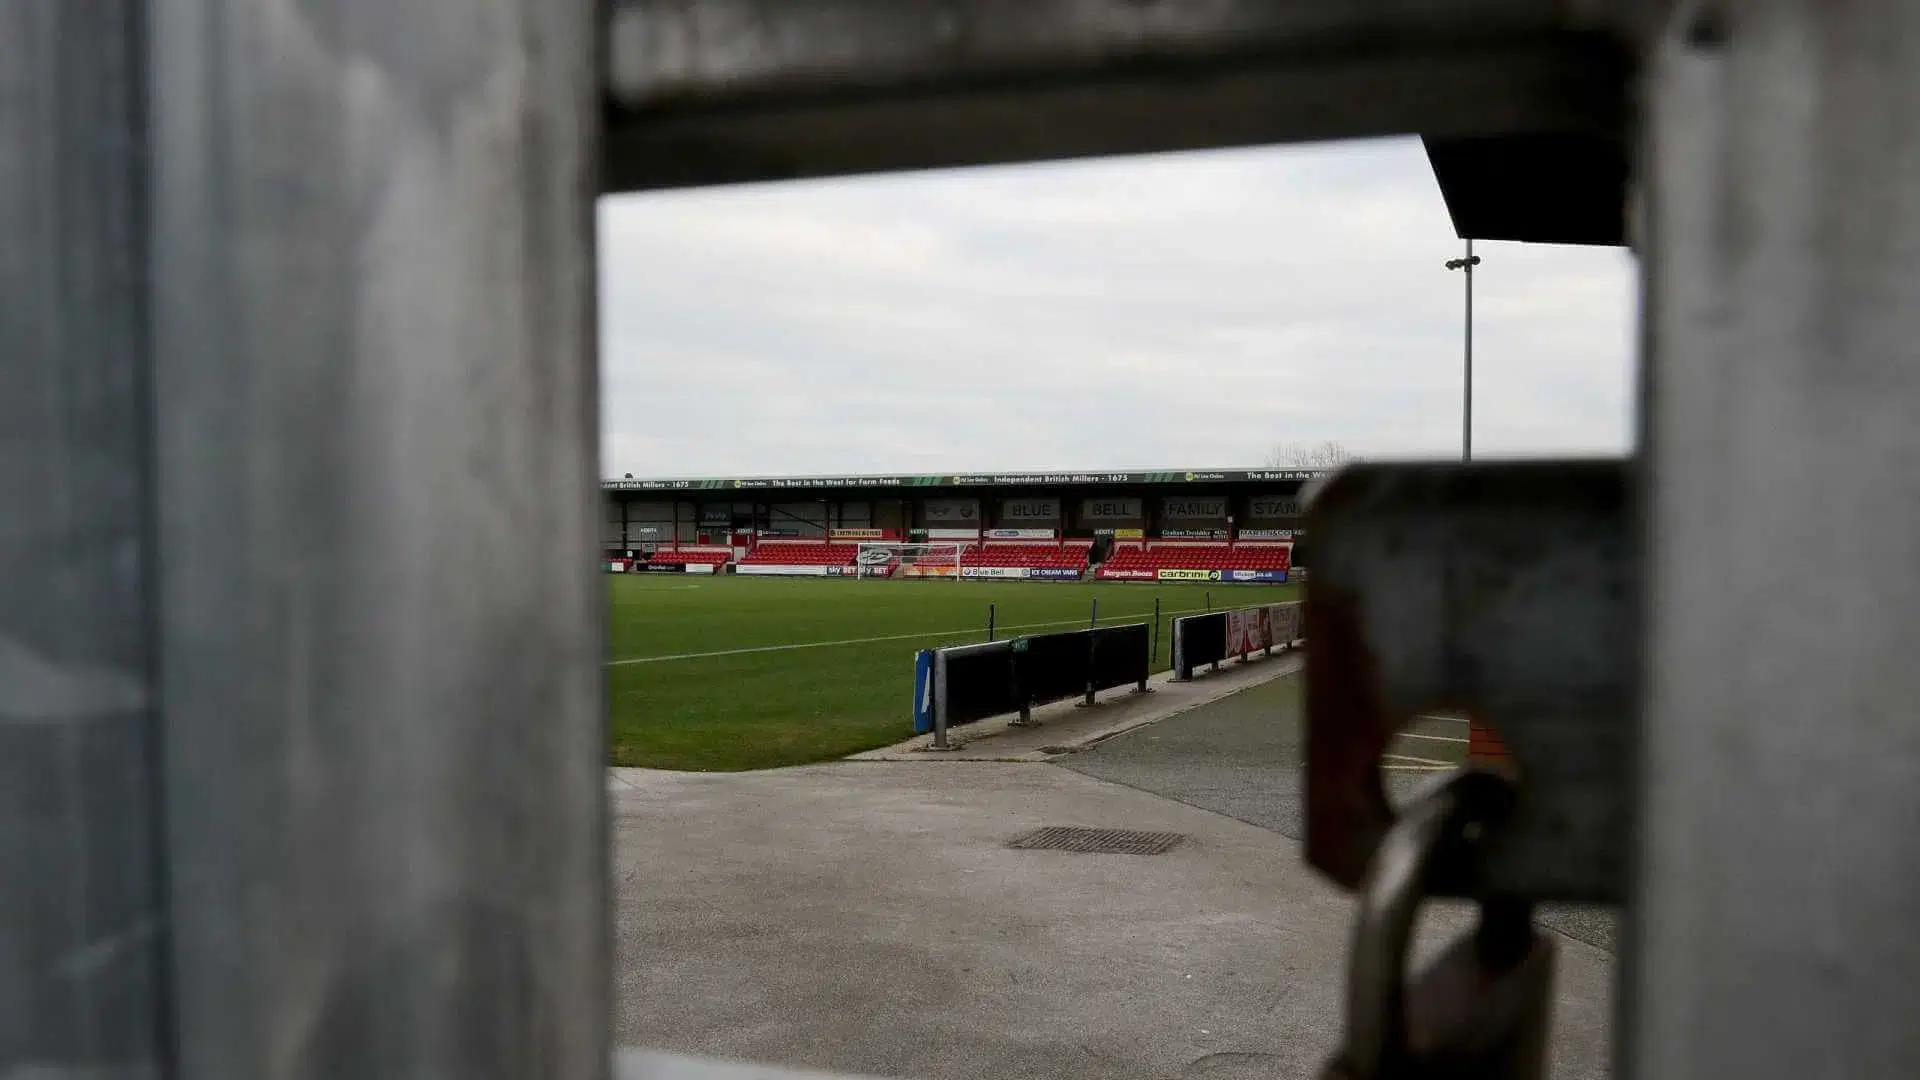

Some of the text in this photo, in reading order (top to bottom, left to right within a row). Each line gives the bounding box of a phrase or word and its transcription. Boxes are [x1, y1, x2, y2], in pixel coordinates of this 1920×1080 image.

[994, 475, 1042, 484] Independent
[619, 481, 641, 489] British
[1012, 502, 1297, 516] BLUE BELL FAMILY STAN
[1103, 570, 1131, 578] Bargain
